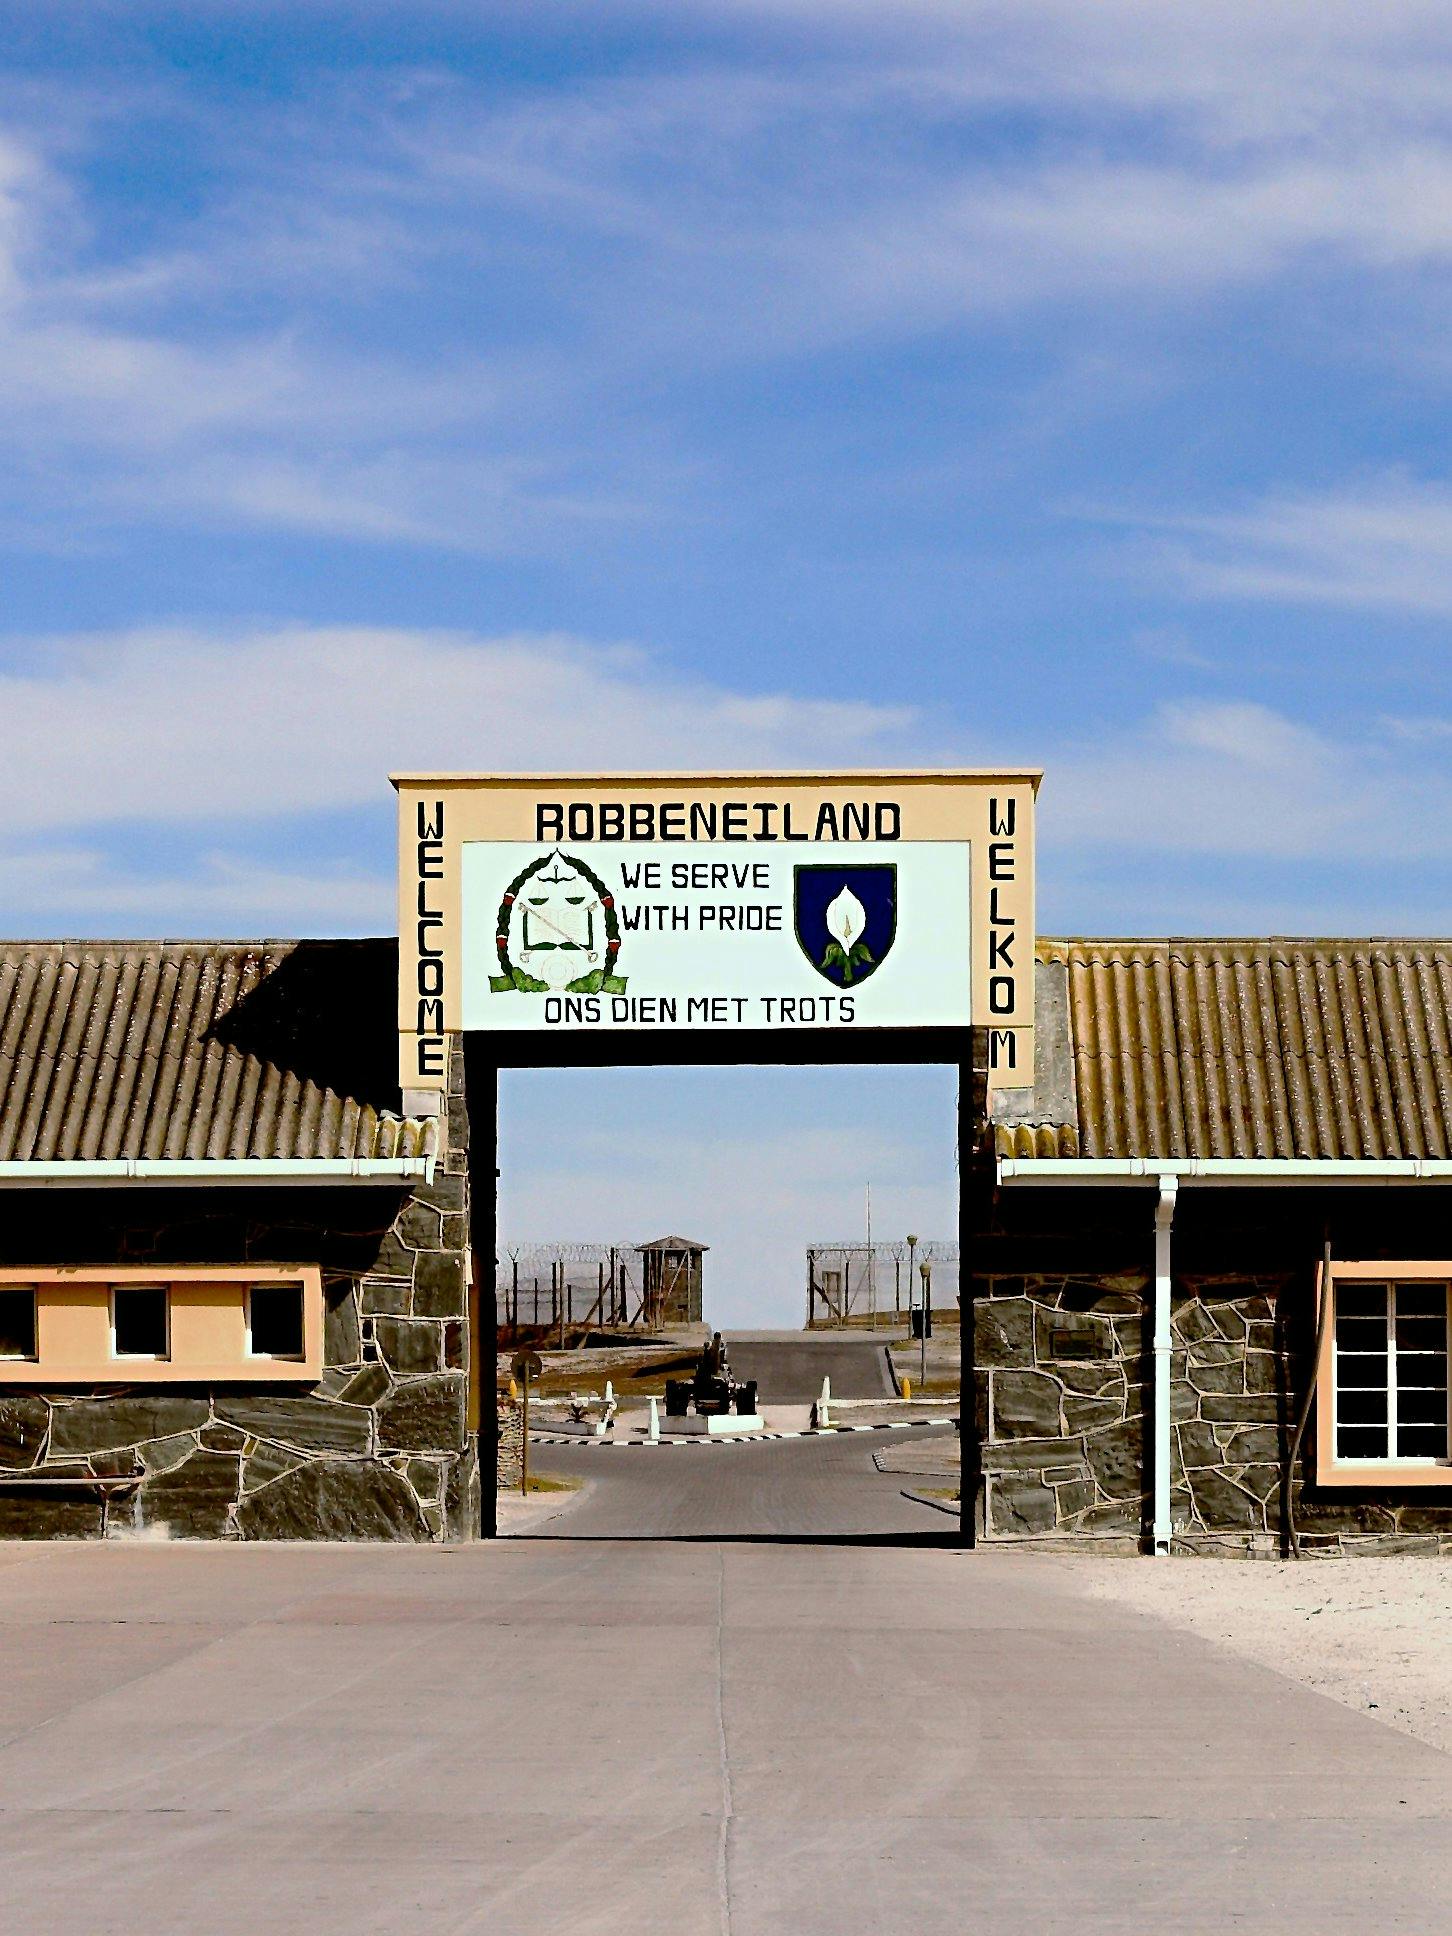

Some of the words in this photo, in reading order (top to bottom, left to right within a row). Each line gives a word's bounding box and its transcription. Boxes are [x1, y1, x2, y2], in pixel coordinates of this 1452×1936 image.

[537, 803, 901, 841] ROBBENEILAND
[621, 863, 661, 888] WE
[671, 863, 770, 889] SERVE
[622, 905, 689, 931] WITH
[700, 905, 783, 931] PRIDE
[989, 798, 1016, 1069] WELKOM
[417, 801, 444, 1076] WELCOME
[545, 998, 601, 1023] ONS
[612, 998, 677, 1023] DIEN
[688, 998, 749, 1022] MET
[760, 997, 855, 1022] TROTS
